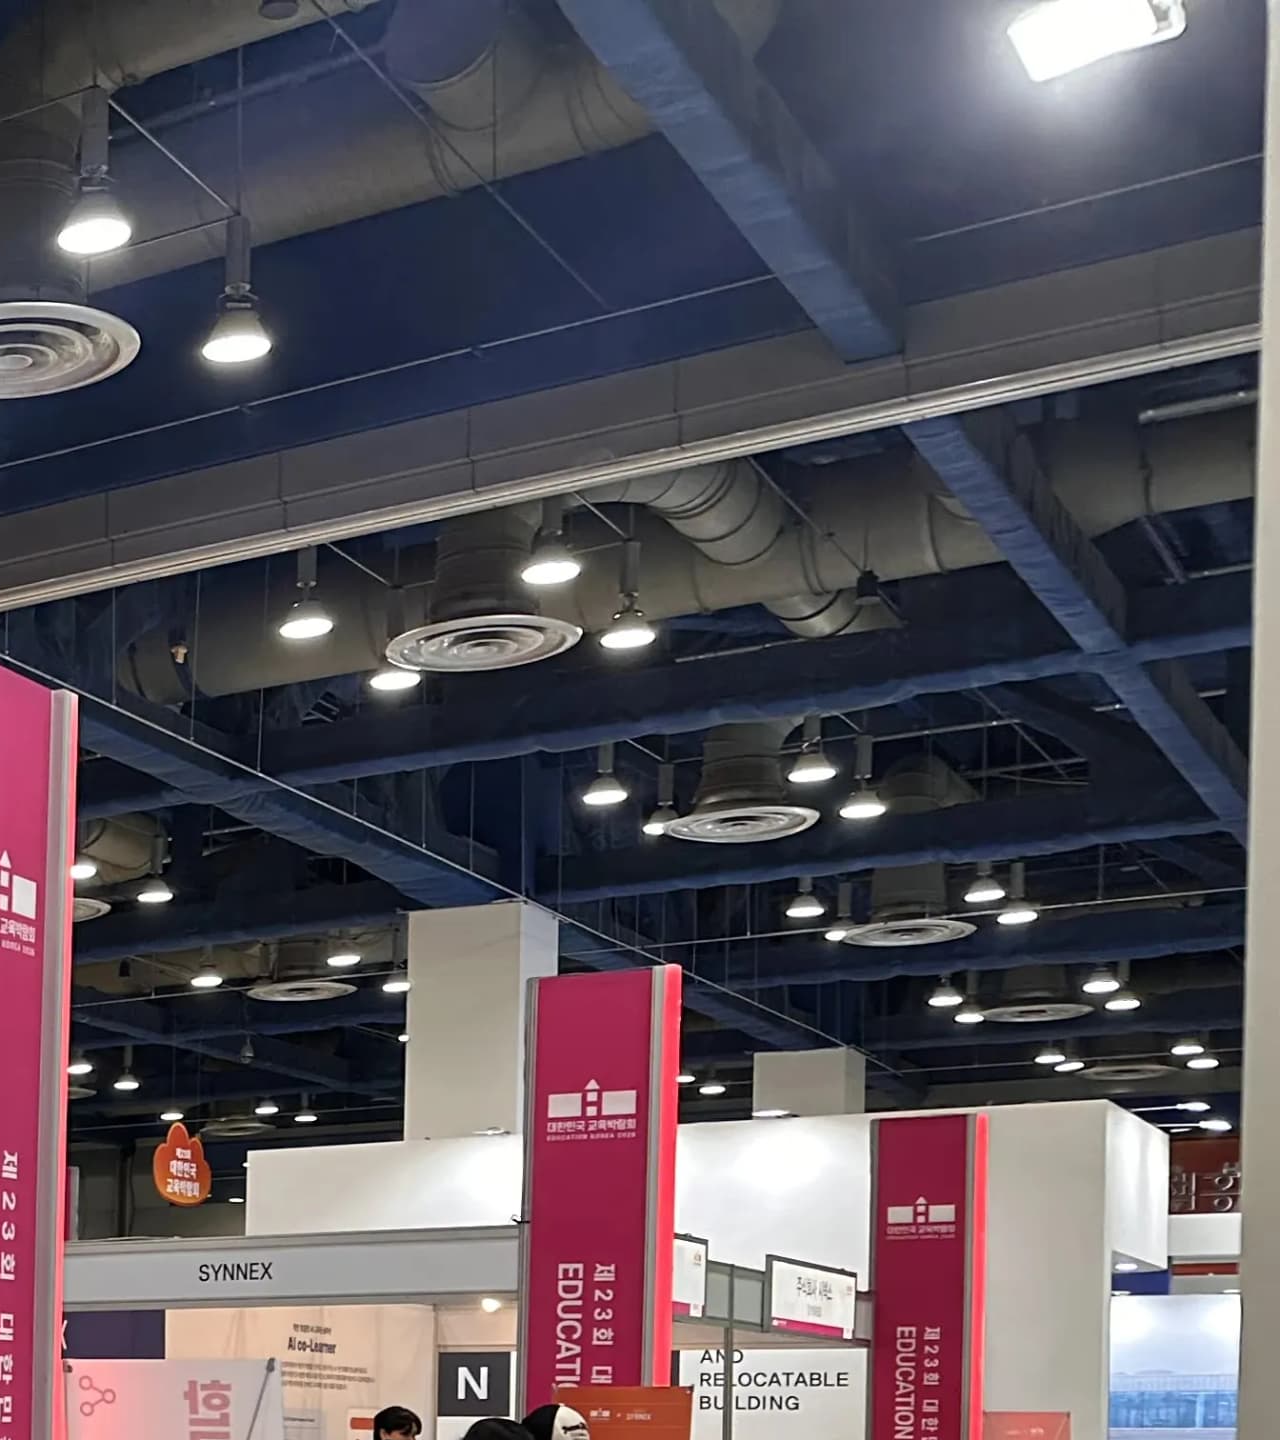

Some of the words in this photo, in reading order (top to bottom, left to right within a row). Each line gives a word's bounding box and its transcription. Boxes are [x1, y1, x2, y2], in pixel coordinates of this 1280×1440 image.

[198, 1262, 274, 1283] SYNNEX
[593, 1263, 615, 1346] 제23회
[922, 1326, 940, 1386] 제23회
[456, 1366, 489, 1400] N
[699, 1395, 800, 1411] BULDING
[894, 1325, 917, 1440] EDUCATION
